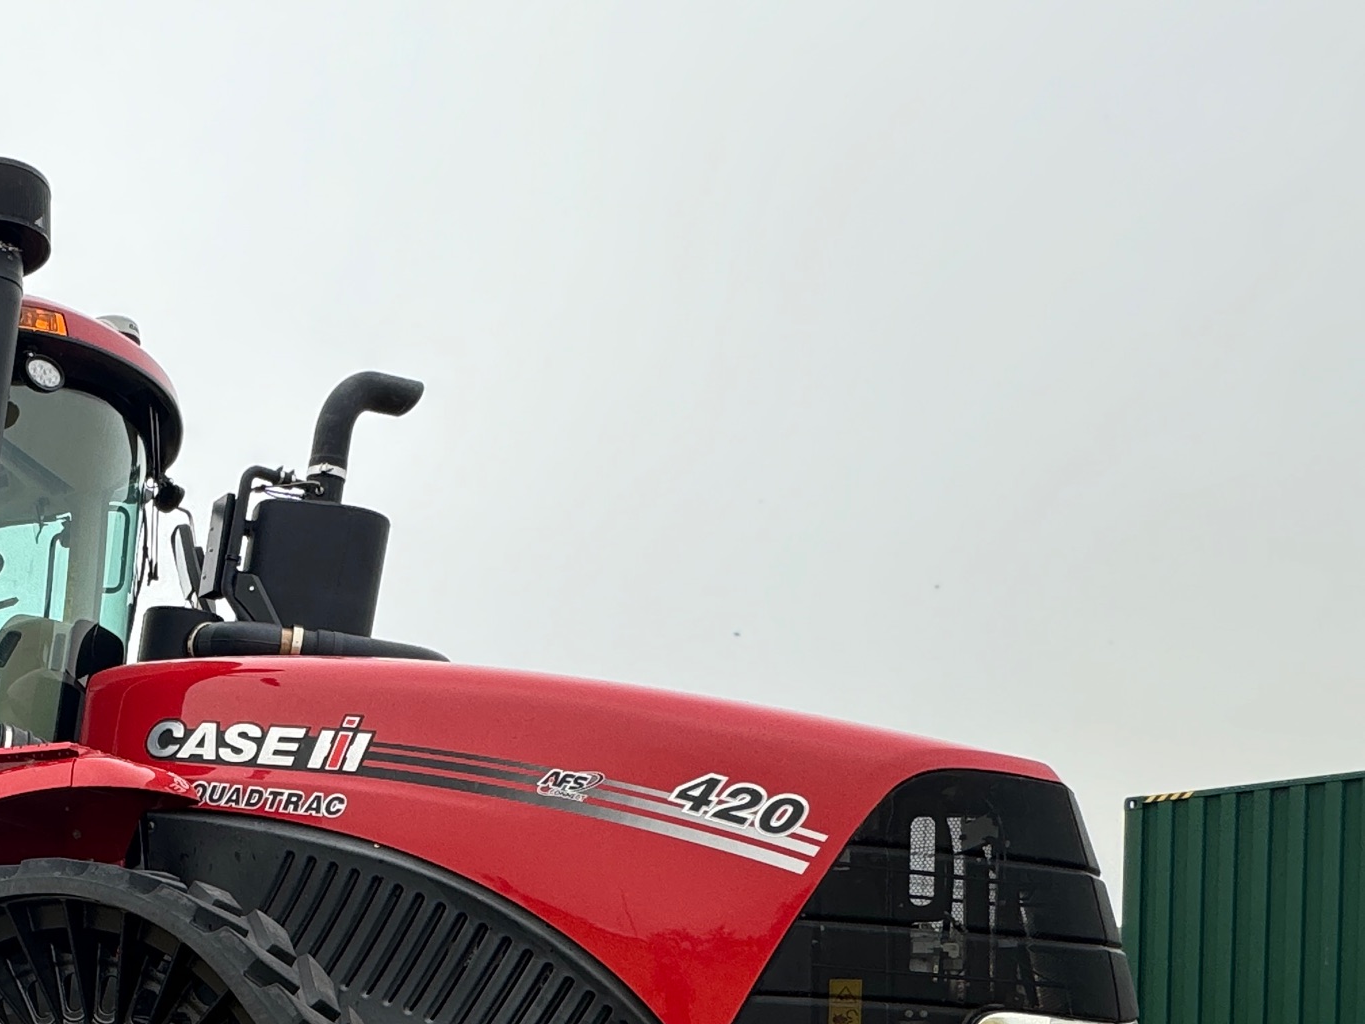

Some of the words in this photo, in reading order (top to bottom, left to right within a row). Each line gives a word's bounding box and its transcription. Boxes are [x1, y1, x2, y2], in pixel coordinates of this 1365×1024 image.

[146, 720, 308, 767] CASE
[538, 769, 590, 791] AFS
[669, 773, 810, 837] 420
